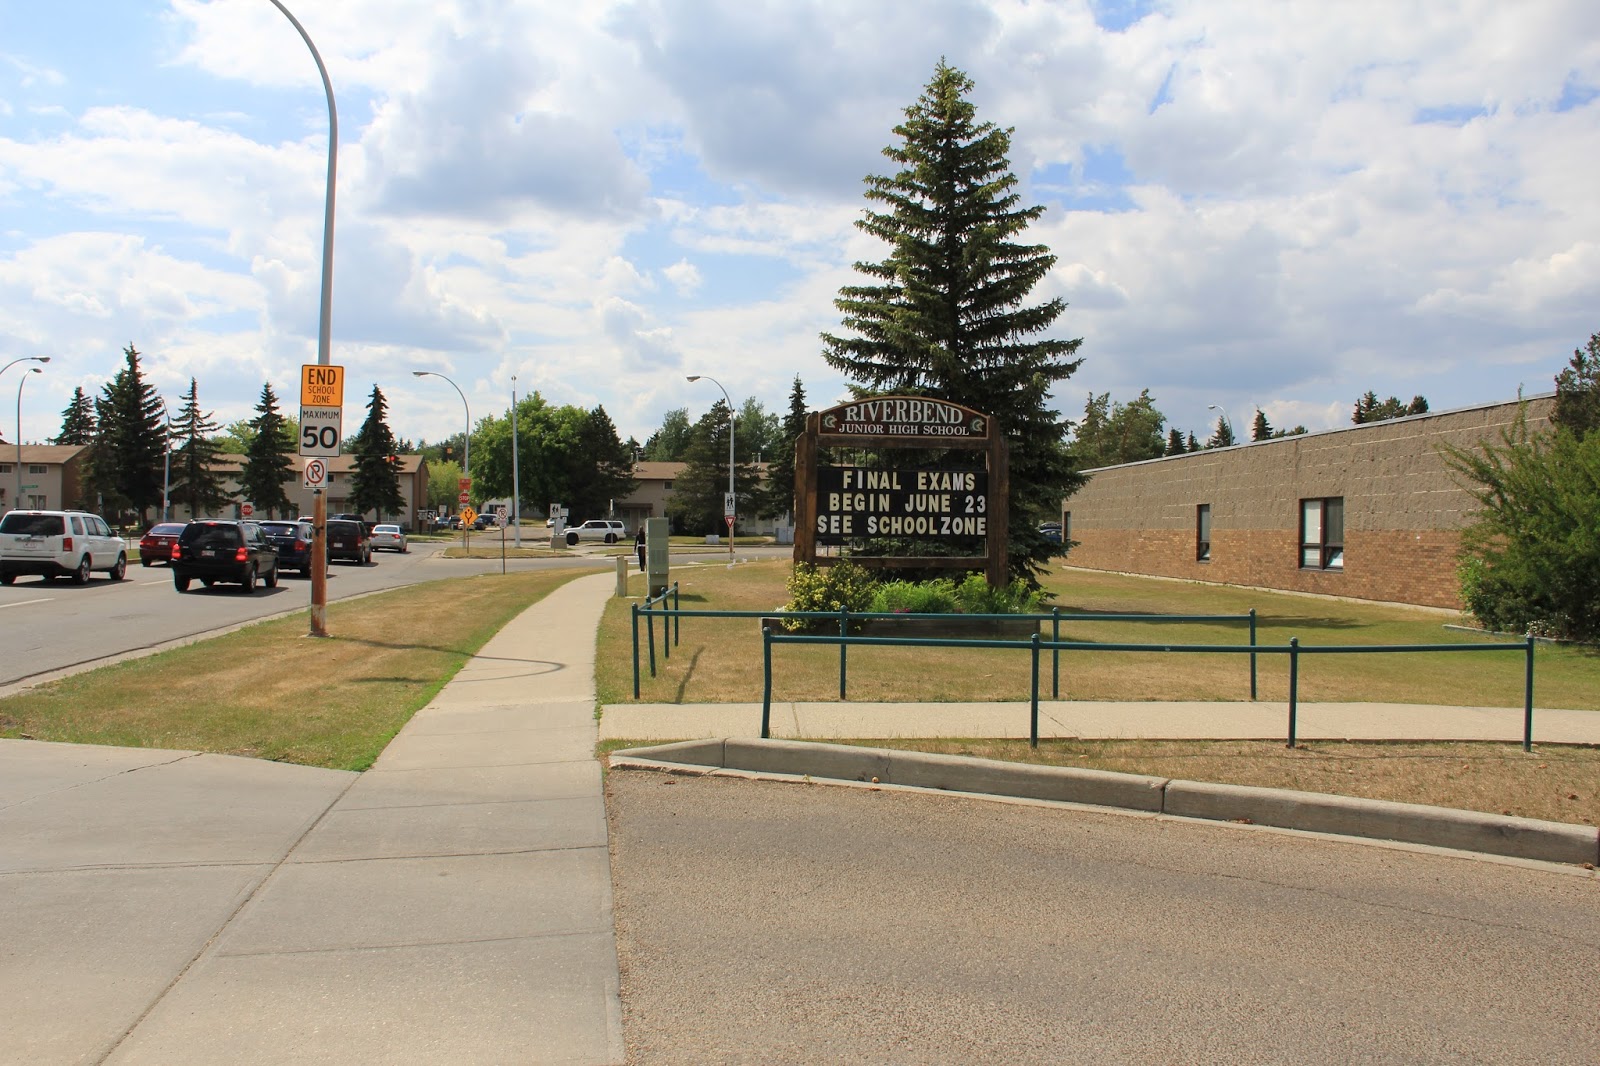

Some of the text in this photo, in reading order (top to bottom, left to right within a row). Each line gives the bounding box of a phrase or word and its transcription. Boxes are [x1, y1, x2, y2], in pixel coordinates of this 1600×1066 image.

[308, 368, 336, 385] END
[308, 386, 335, 395] SCHOOL
[312, 395, 330, 403] ZONE
[302, 410, 339, 420] MAXIMUM
[845, 400, 963, 424] RIVERBEND
[302, 426, 338, 449] 50
[839, 423, 970, 436] JUNIOR HIGH SCHOOL
[843, 470, 975, 491] FINAL EXAMS
[829, 493, 986, 513] BEGIN JUNE 23
[817, 515, 853, 534] SEE
